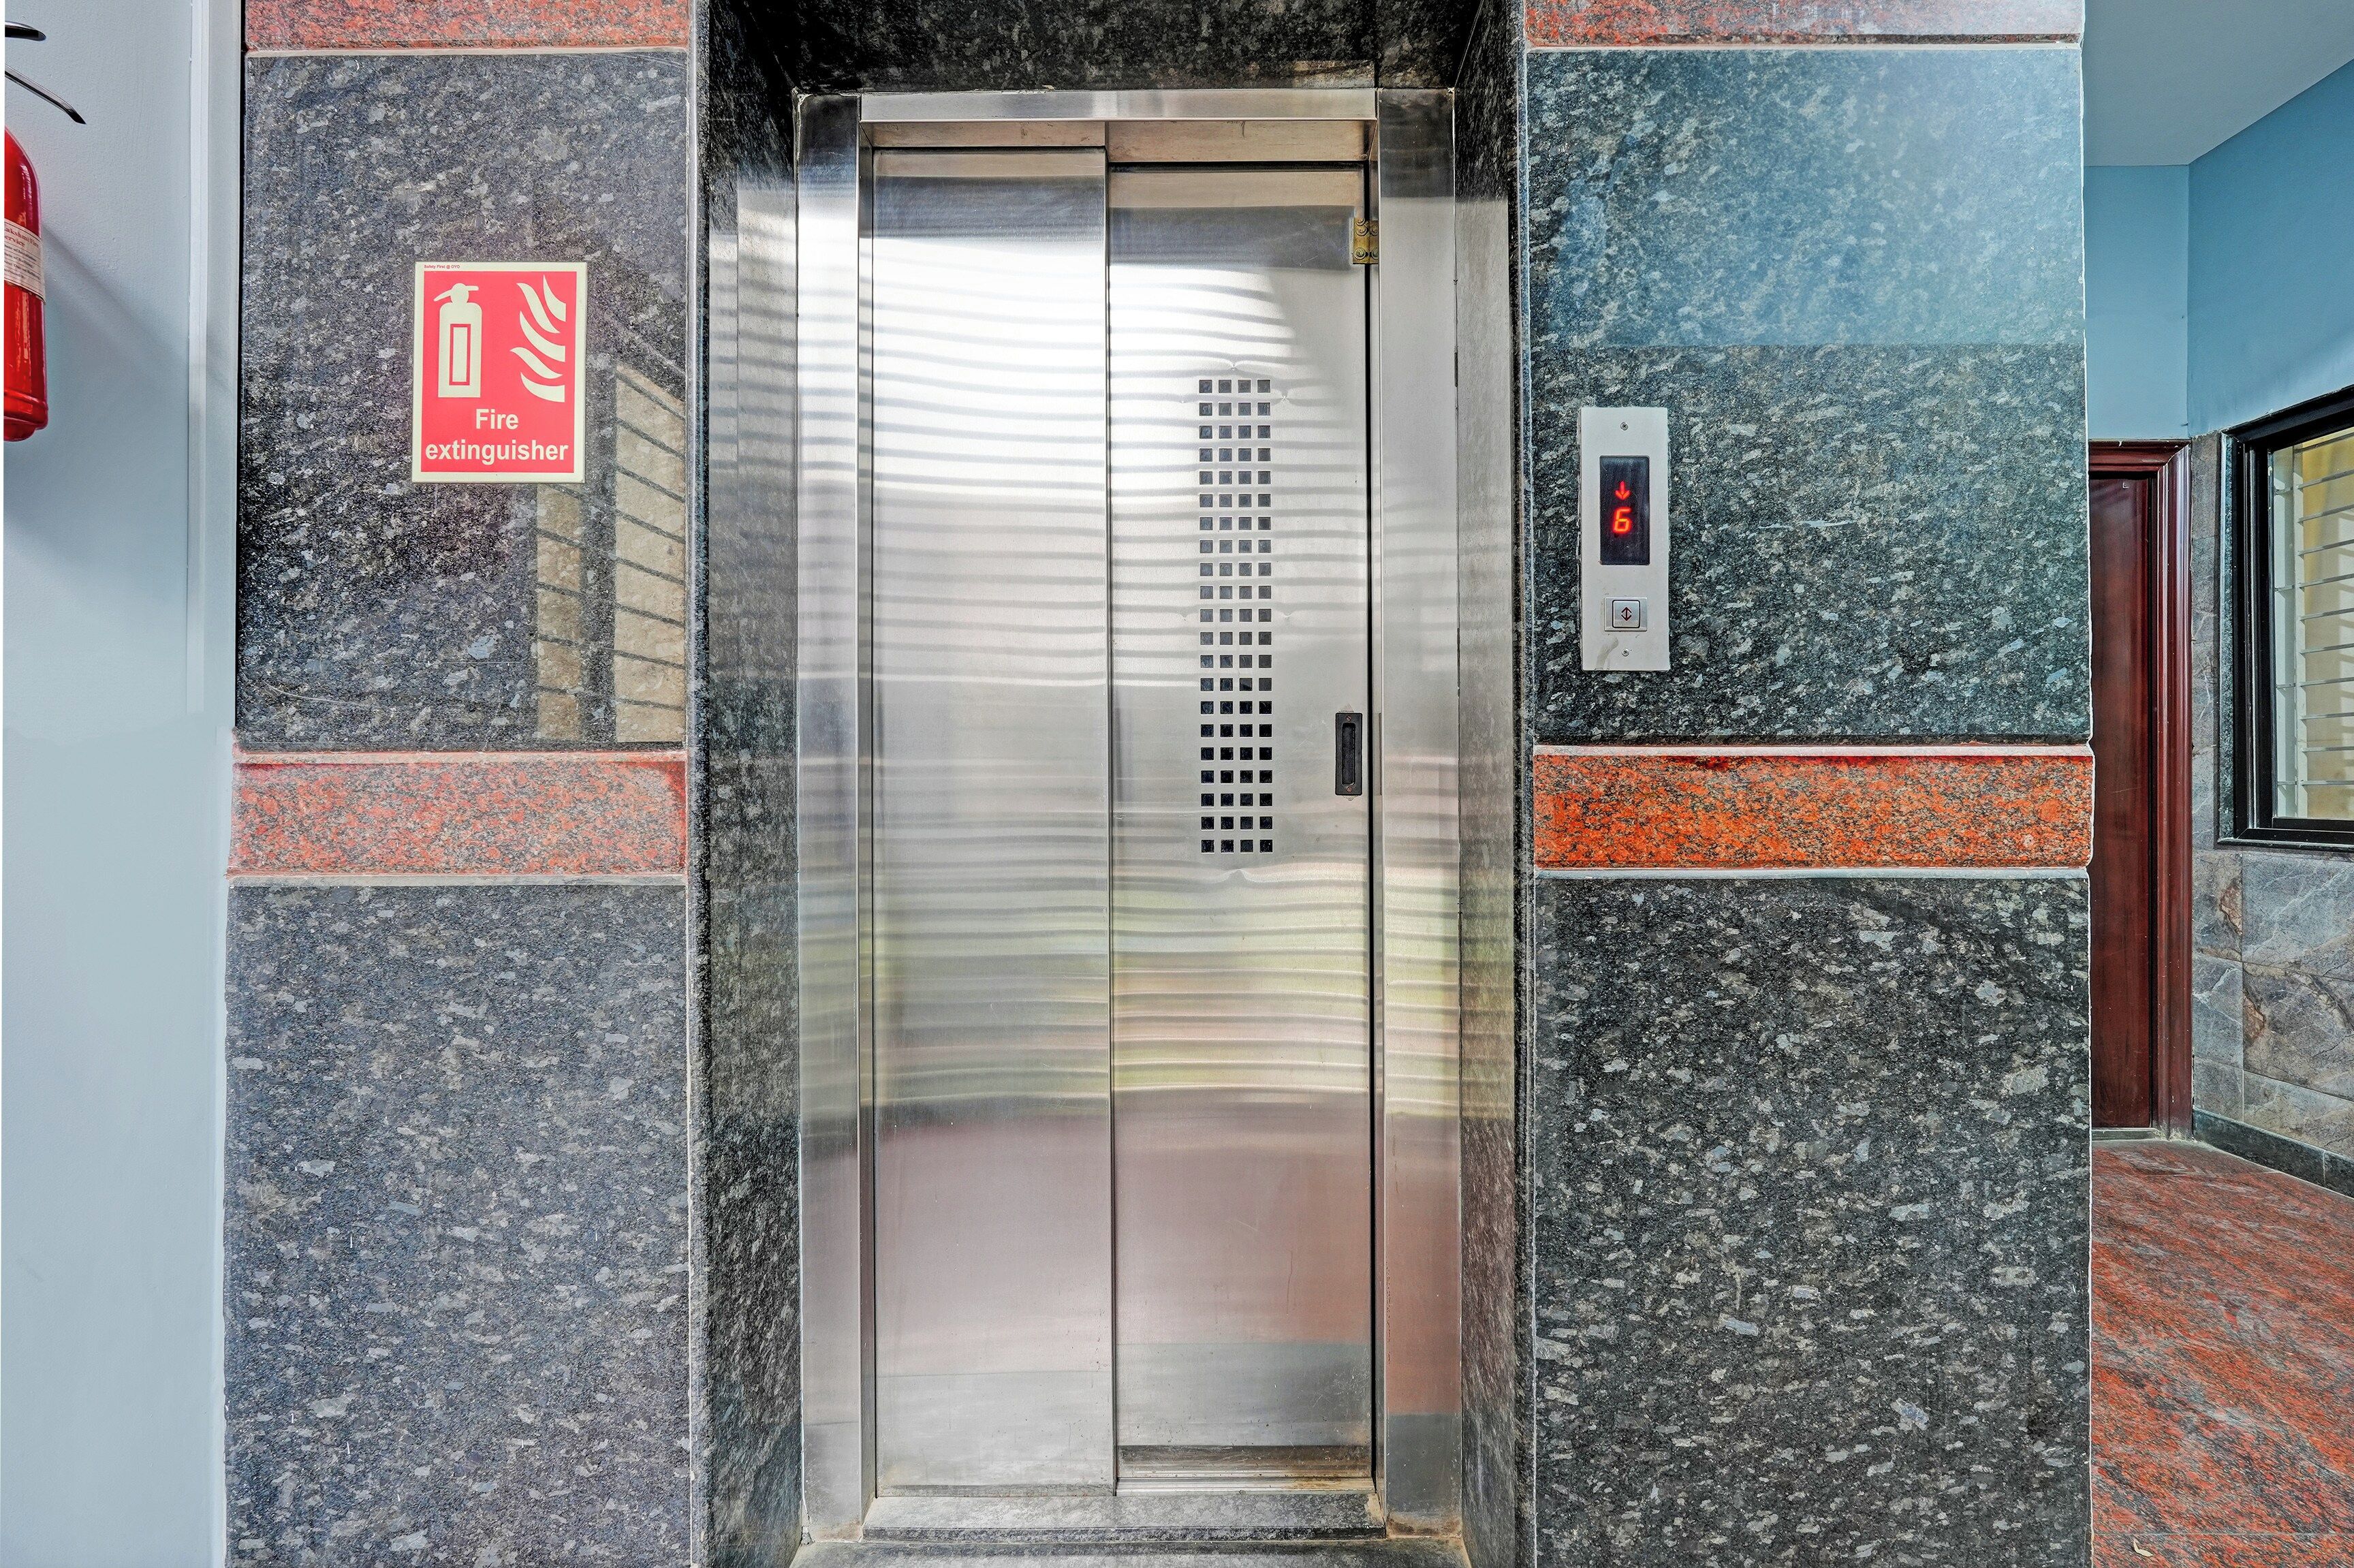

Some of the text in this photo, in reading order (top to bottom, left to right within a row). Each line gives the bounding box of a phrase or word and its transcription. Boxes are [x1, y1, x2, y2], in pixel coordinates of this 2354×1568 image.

[4, 228, 29, 242] akshmi
[4, 236, 25, 247] ervice
[476, 409, 519, 430] Fire
[425, 439, 569, 465] extinguisher
[1613, 506, 1632, 533] 6
